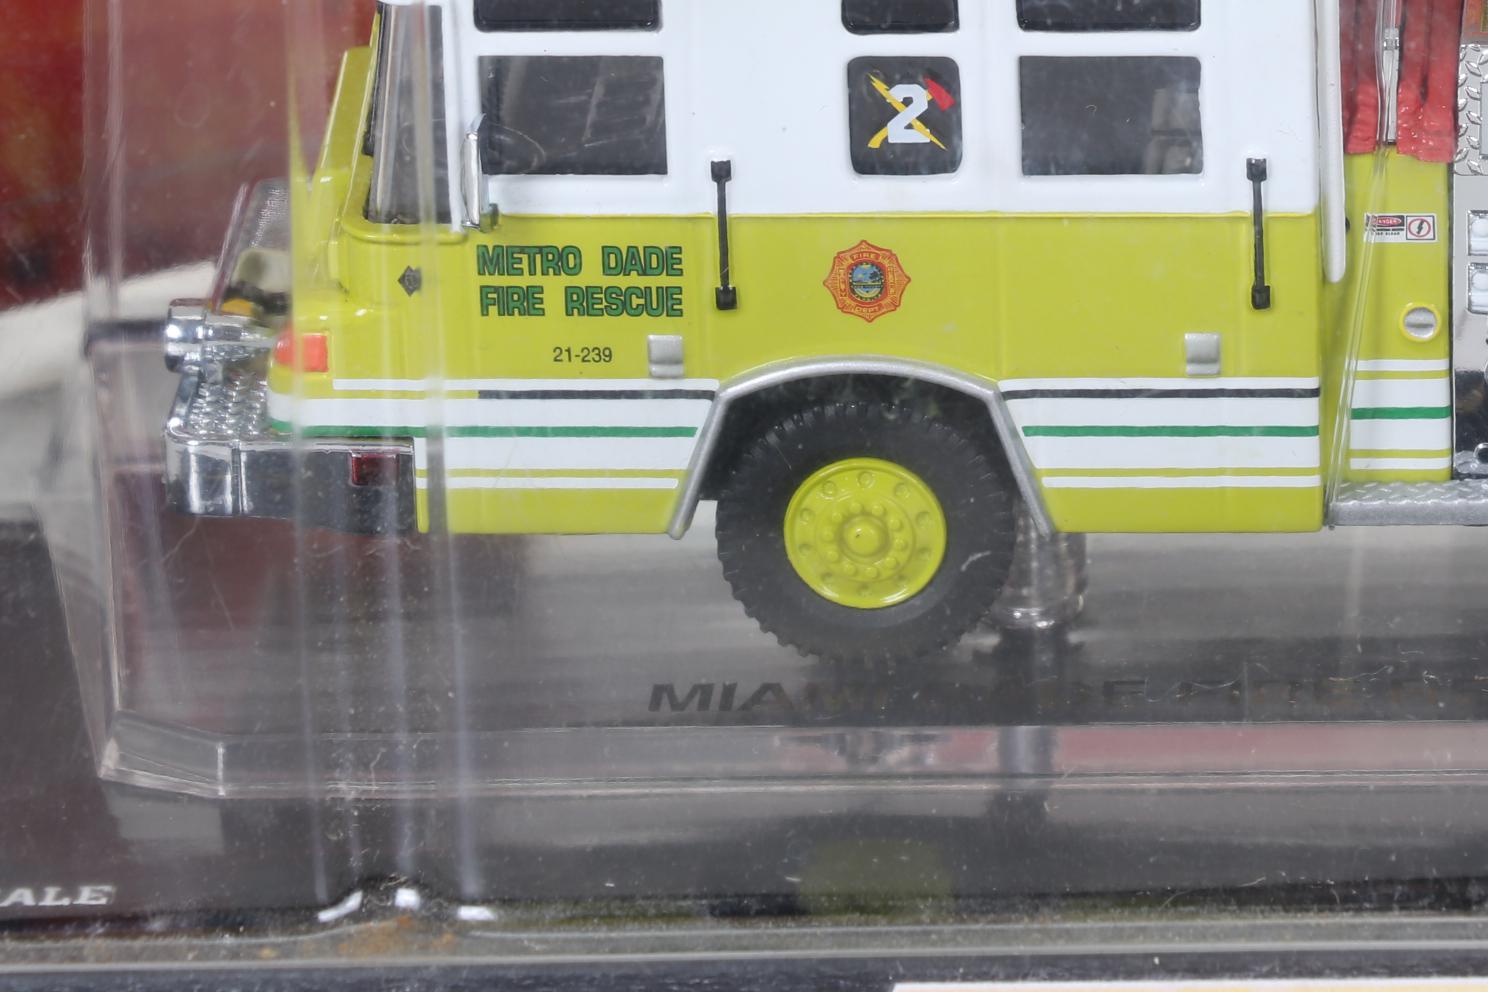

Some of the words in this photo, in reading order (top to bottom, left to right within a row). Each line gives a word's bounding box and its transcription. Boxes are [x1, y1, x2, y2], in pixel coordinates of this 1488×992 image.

[886, 83, 931, 144] 2
[476, 245, 583, 276] METRO
[601, 245, 684, 276] DADE
[479, 285, 545, 317] FIRE
[564, 286, 684, 317] RESCUE
[553, 346, 613, 363] 21-239
